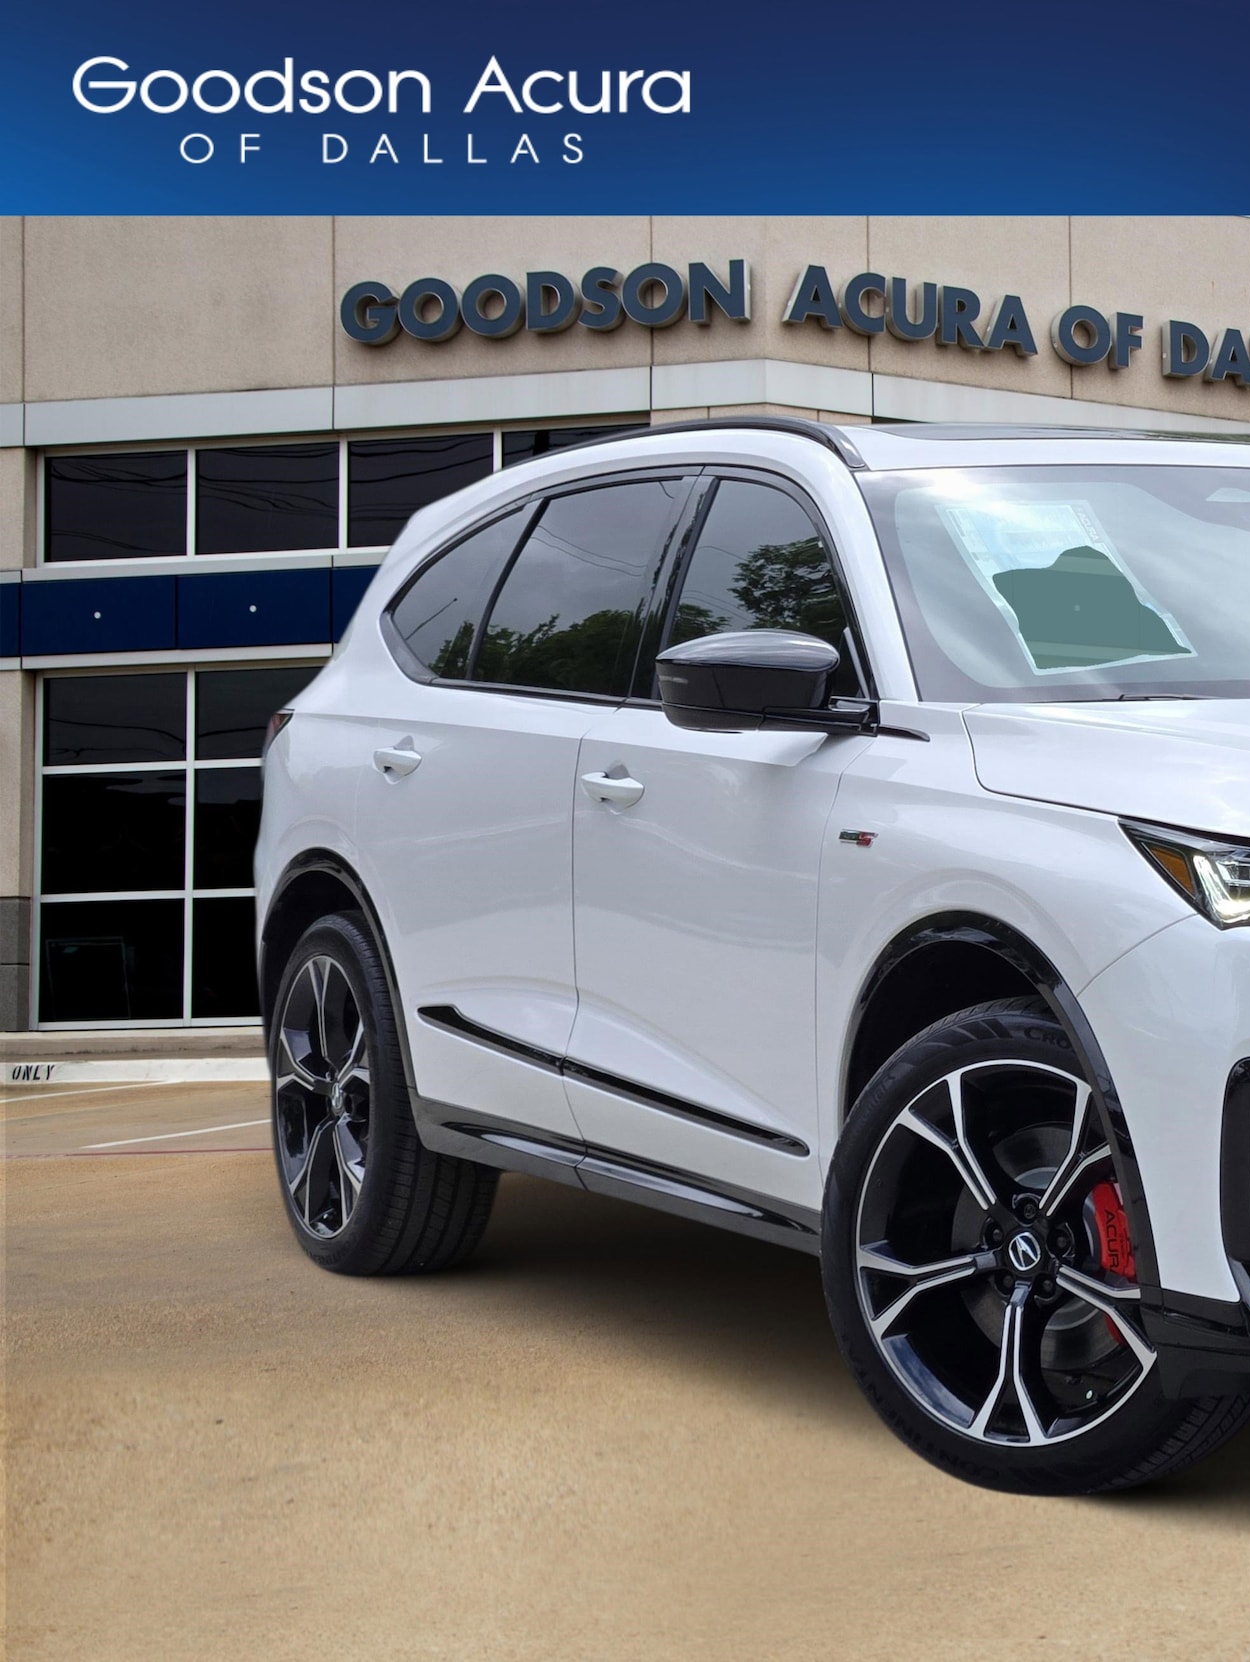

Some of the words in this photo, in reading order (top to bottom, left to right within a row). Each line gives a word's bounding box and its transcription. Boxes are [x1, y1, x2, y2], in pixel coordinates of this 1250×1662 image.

[340, 258, 752, 346] GOODSON
[783, 264, 1038, 357] ACURA
[1051, 304, 1144, 370] OF
[1024, 1026, 1074, 1051] CRO
[11, 1064, 55, 1081] ONLY
